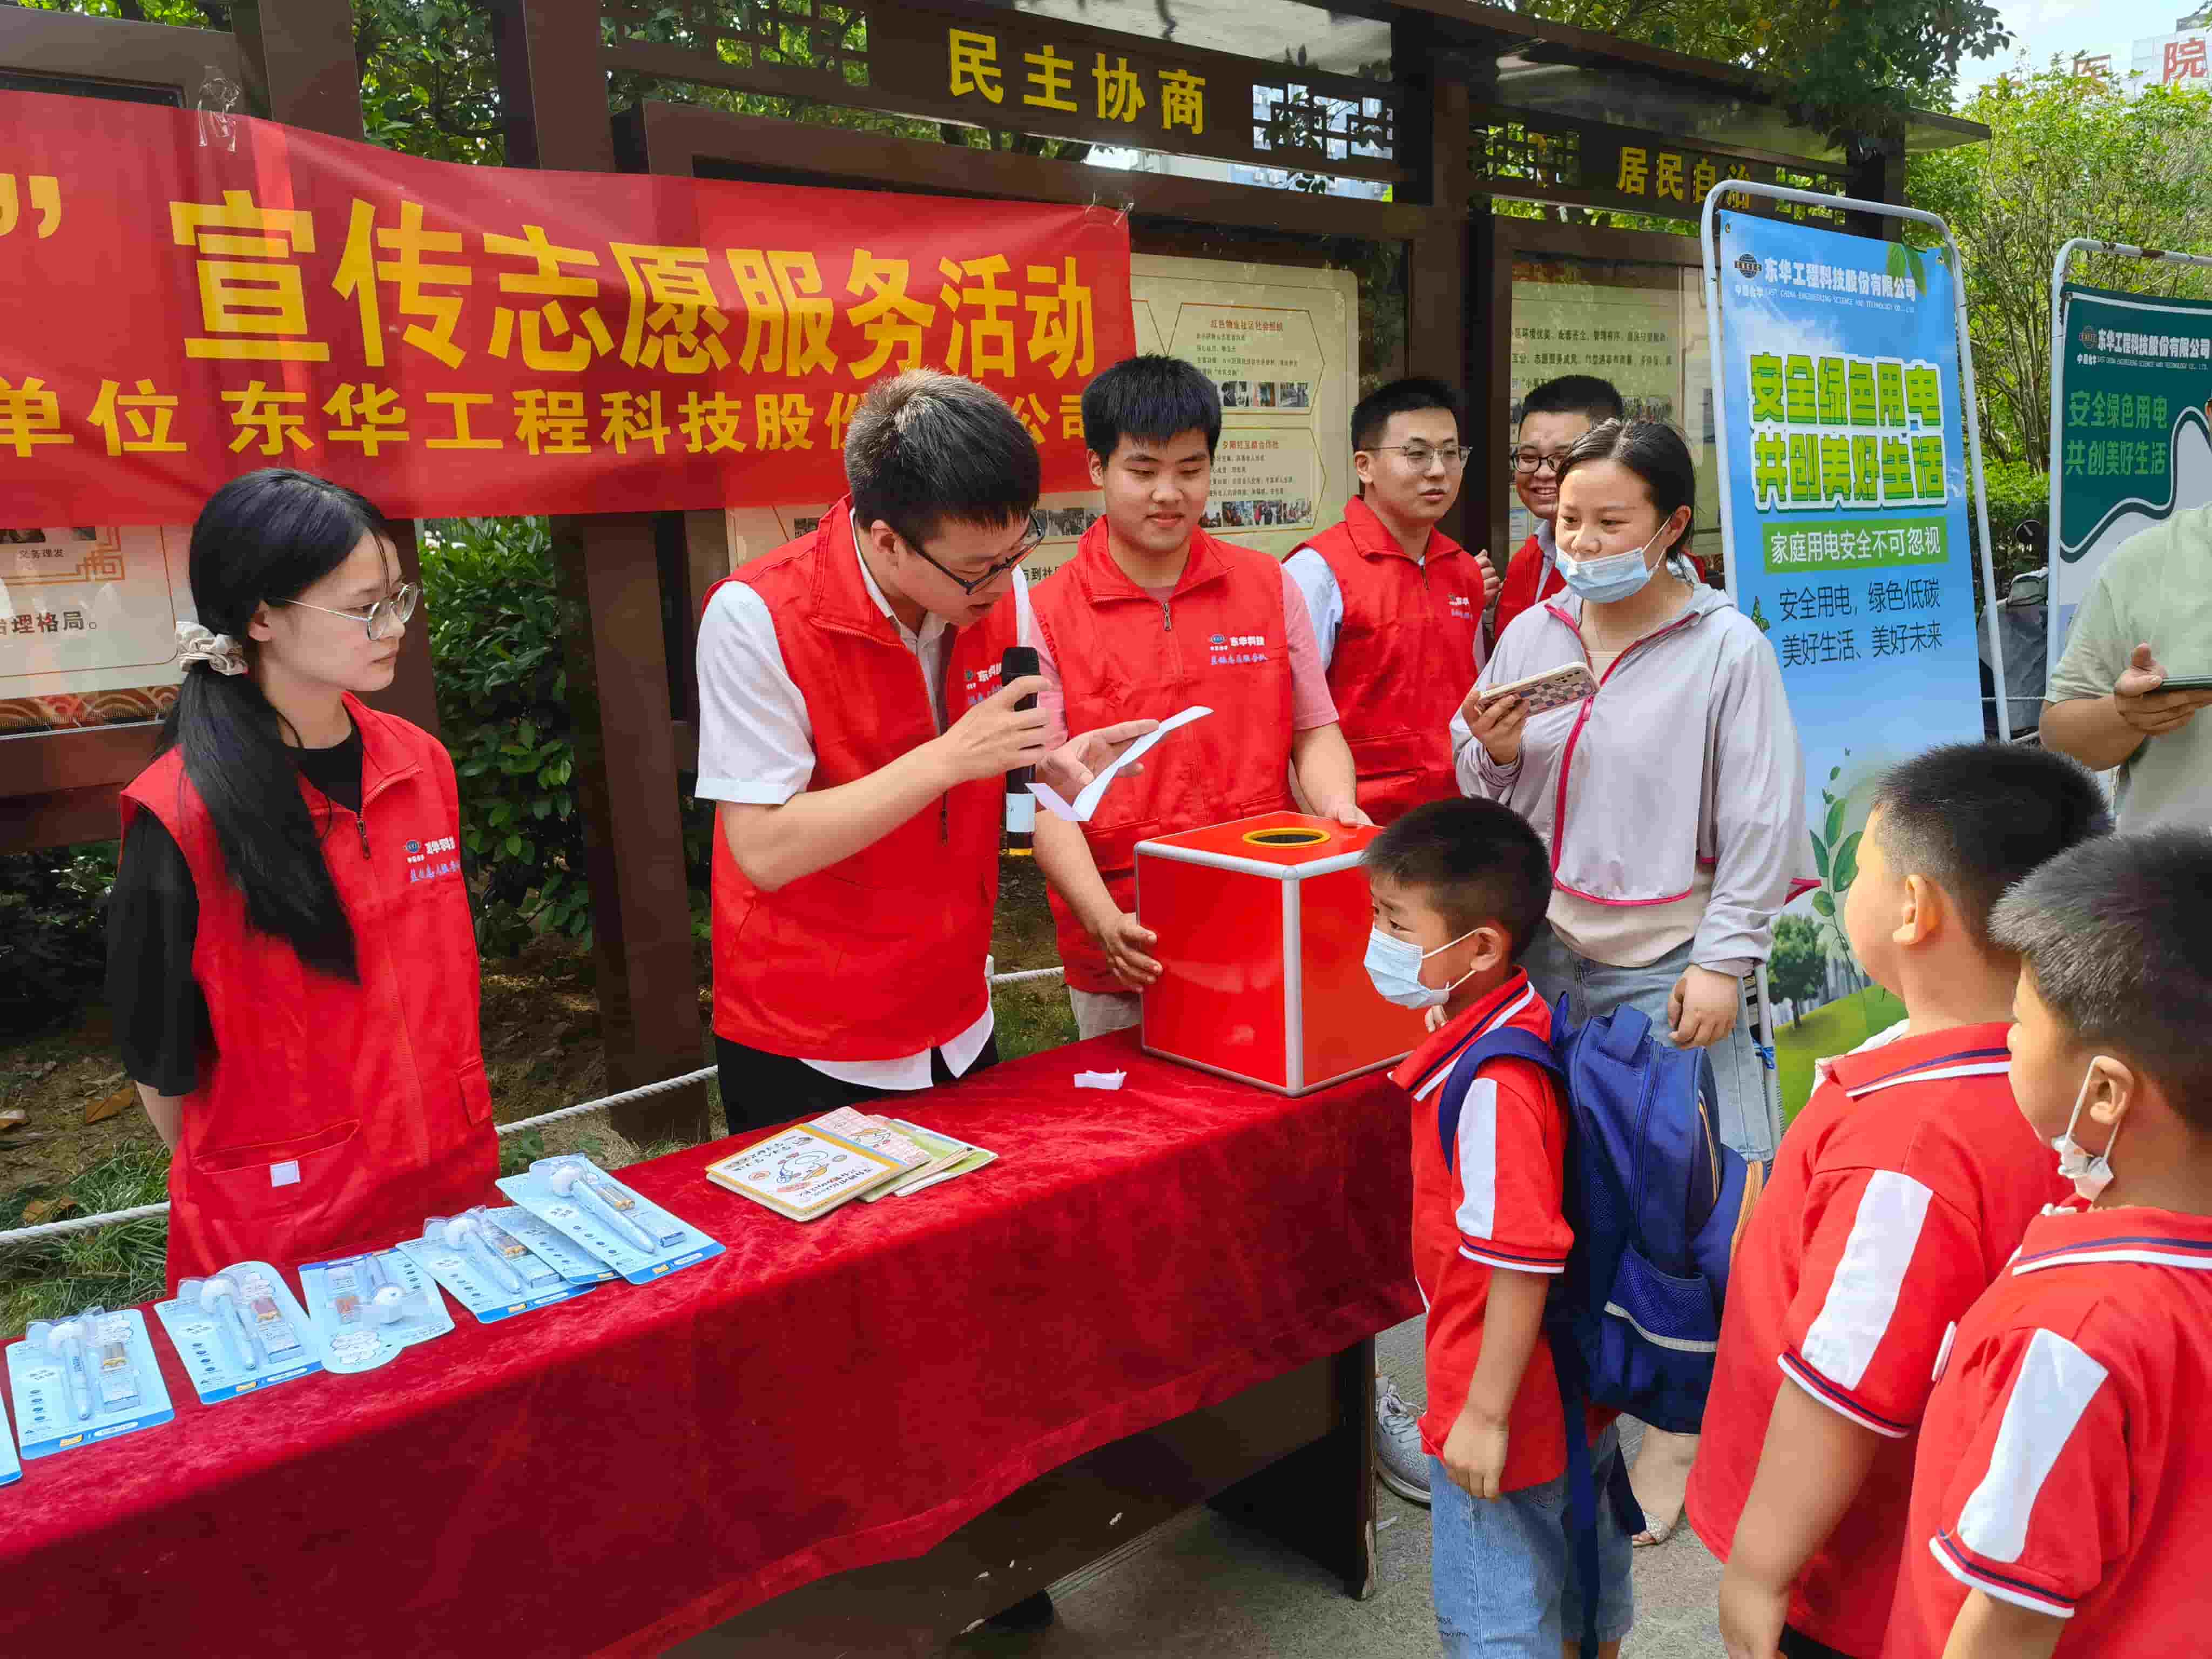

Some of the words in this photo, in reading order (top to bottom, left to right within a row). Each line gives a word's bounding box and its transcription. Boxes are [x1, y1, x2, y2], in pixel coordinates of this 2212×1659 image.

[949, 28, 1206, 134] 民主协商
[1764, 257, 1916, 301] 东华工程科技股份有限公司
[2098, 328, 2210, 359] 东华工程科技股份有限公司
[1750, 352, 1942, 427] 安全绿色用电
[2067, 390, 2169, 429] 安全绿色用电
[221, 380, 1085, 457] 东华工程科技股份公司
[1755, 431, 1945, 503] 共创美好生活
[2065, 440, 2167, 476] 共创美好生活
[18, 548, 65, 559] 义务理发
[1770, 526, 1940, 564] 家庭用电安全不可忽视
